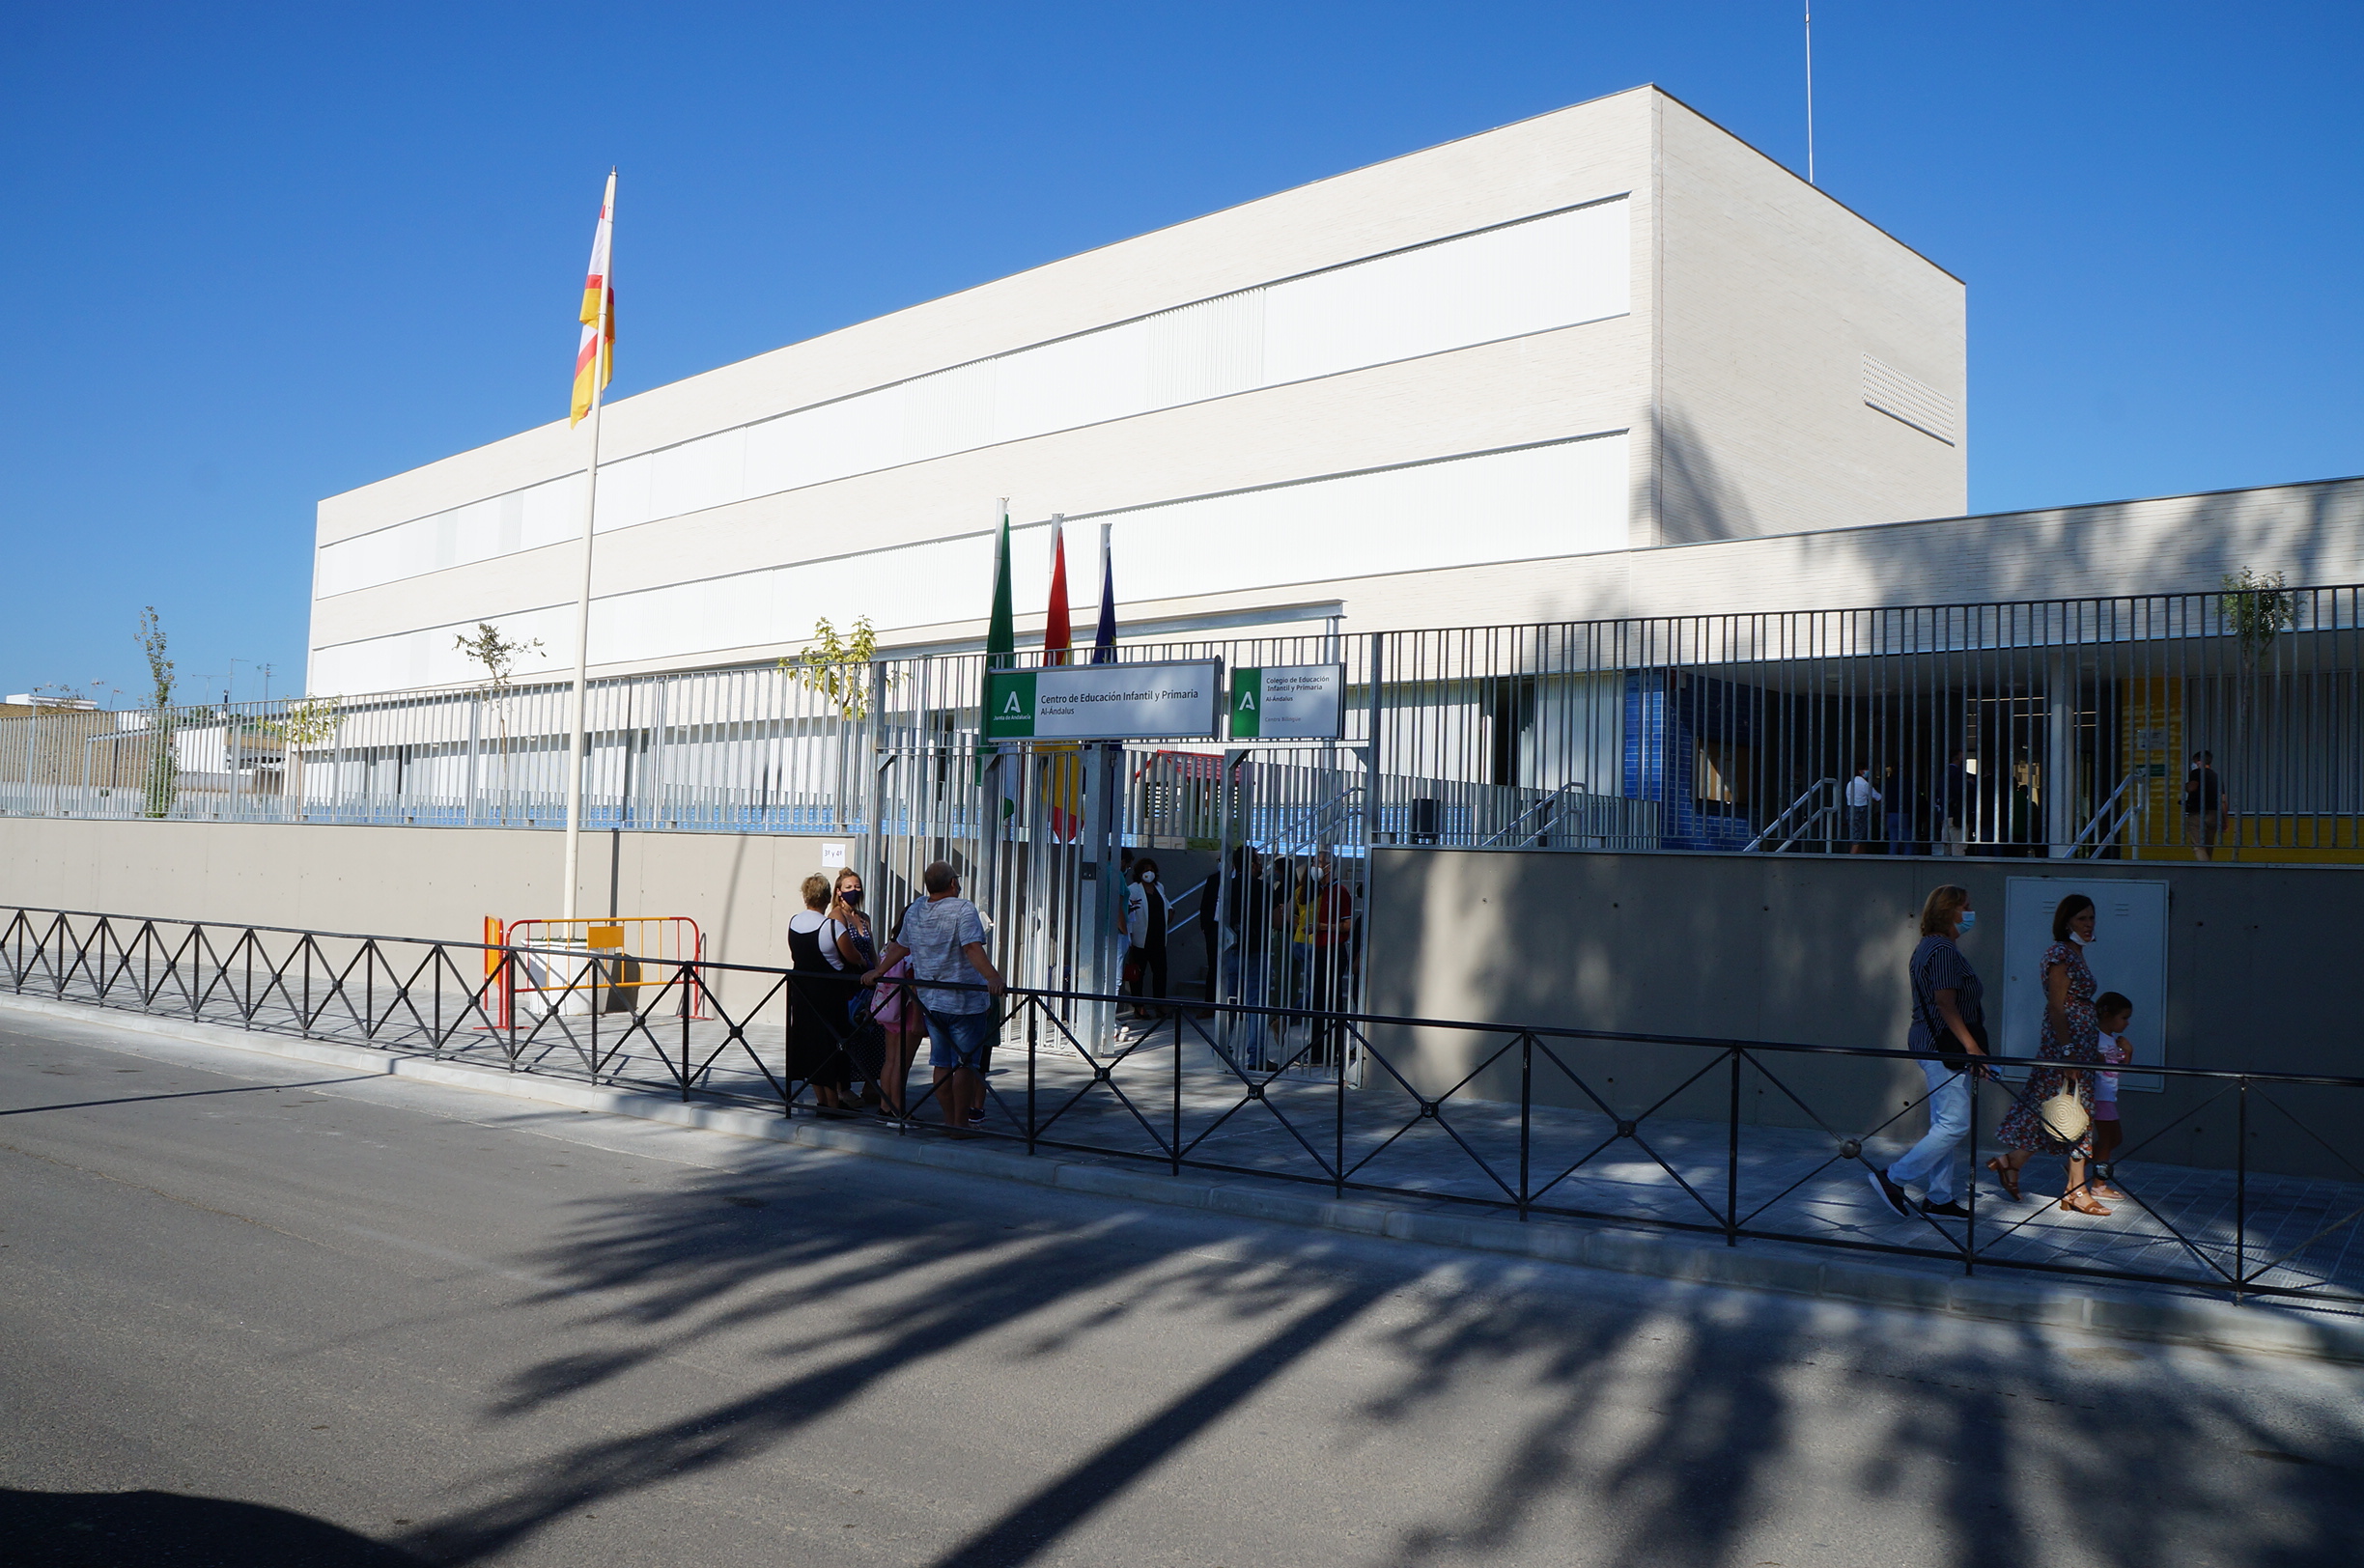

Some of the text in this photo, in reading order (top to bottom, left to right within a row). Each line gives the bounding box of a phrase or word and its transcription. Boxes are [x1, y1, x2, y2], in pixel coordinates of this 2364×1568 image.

[1041, 689, 1198, 704] Centro de Educación Infantil y Primaria
[1040, 706, 1075, 715] Al-Ándalus
